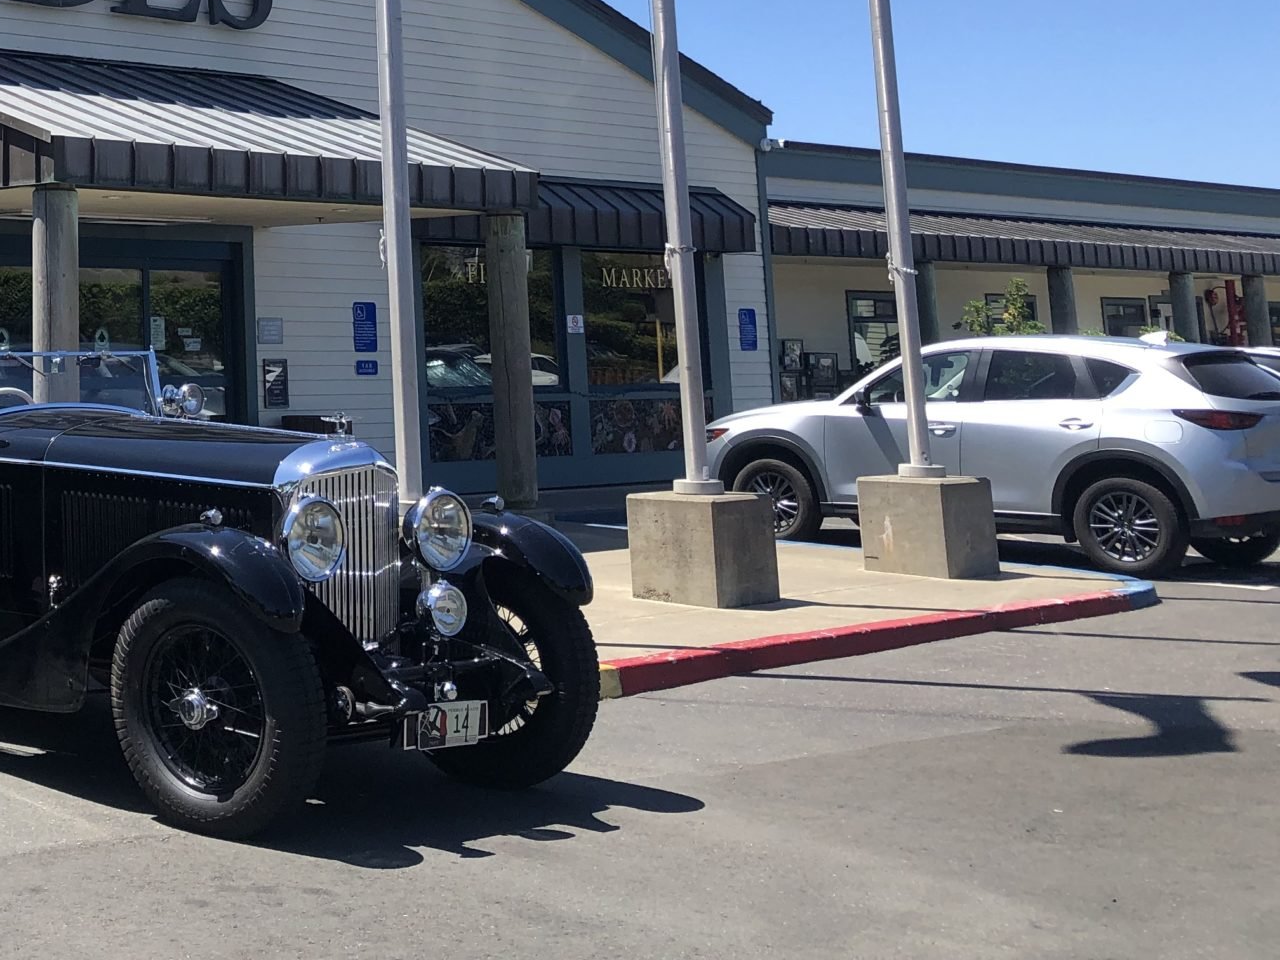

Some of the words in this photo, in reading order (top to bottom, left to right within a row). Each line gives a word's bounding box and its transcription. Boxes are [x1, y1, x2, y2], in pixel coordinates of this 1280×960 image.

[466, 262, 486, 284] FI
[601, 267, 673, 289] MARKE
[453, 704, 469, 743] 14
